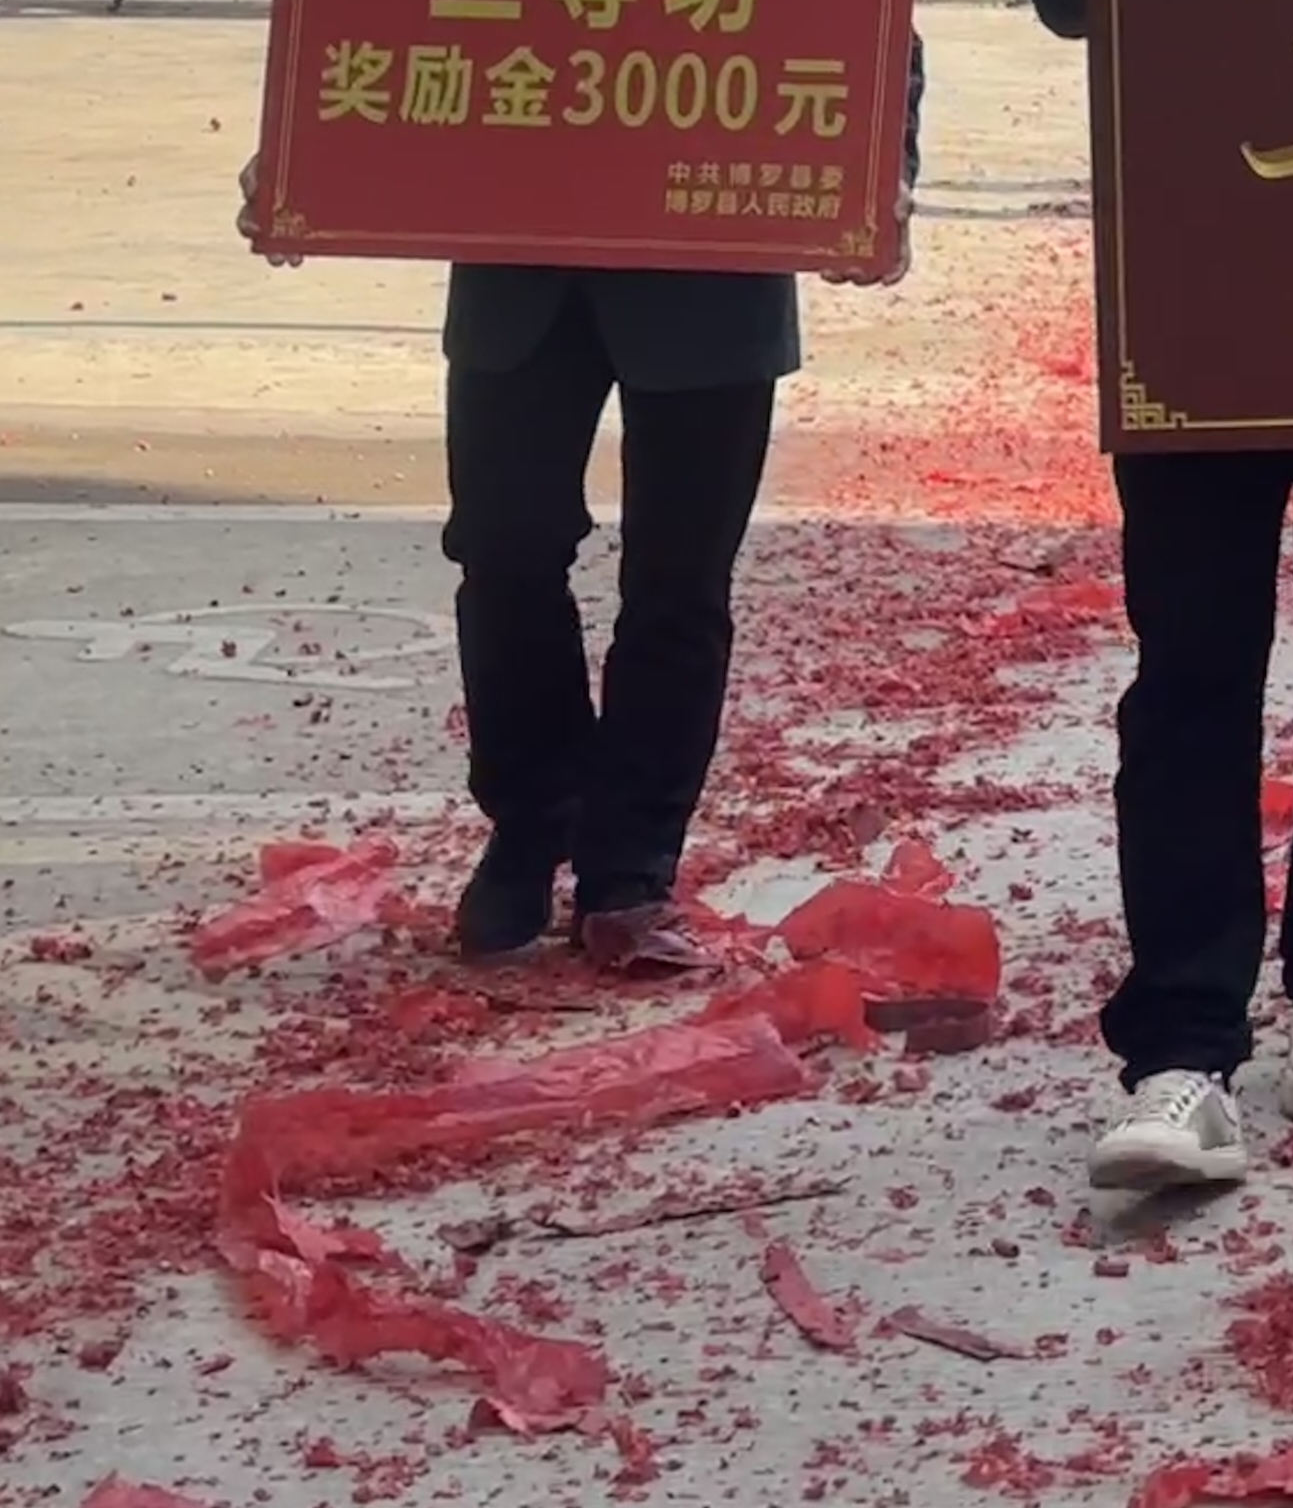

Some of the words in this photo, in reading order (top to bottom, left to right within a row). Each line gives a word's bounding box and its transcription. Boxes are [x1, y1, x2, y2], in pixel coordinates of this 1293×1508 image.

[318, 39, 849, 138] 奖励金3000元
[667, 160, 845, 191] 中共博罗县委
[664, 188, 843, 220] 博罗县人民政府
